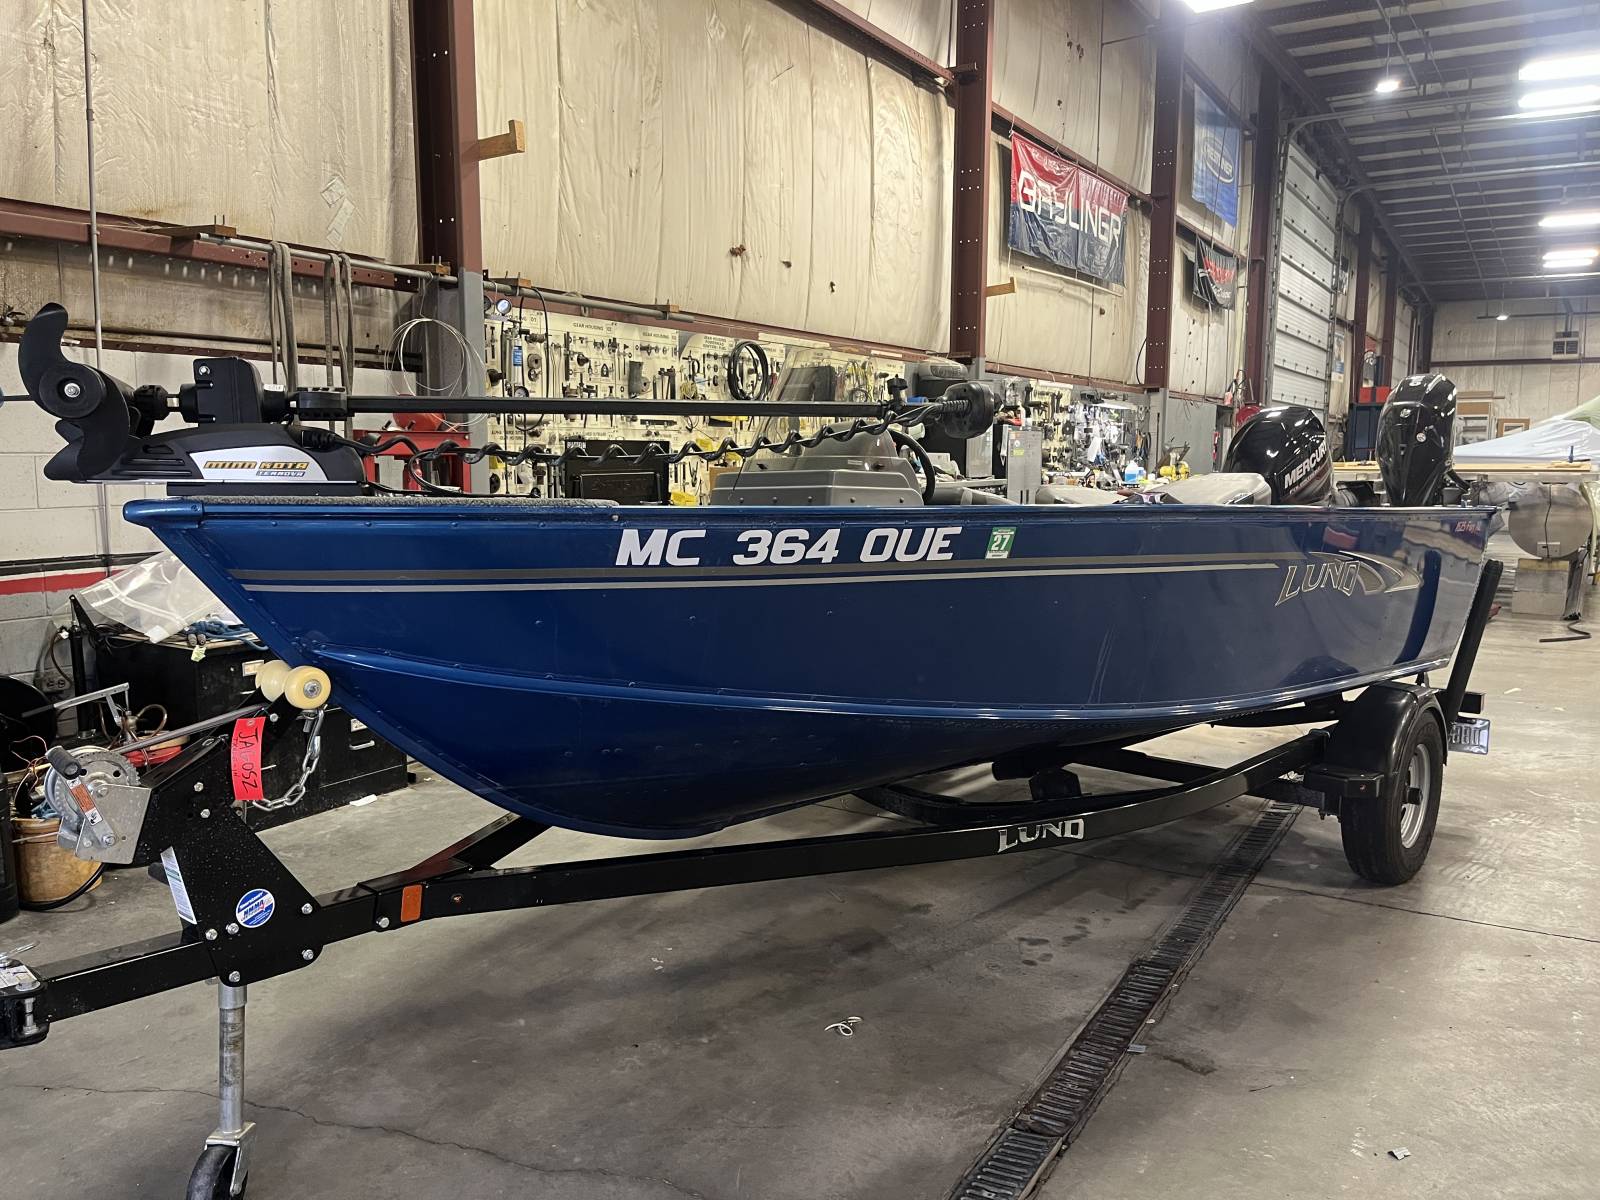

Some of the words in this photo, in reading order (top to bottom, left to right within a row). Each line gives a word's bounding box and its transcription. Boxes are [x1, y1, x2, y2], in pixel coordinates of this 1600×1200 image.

[259, 462, 309, 470] KOTA
[615, 528, 706, 566] MC
[732, 528, 841, 565] 364
[859, 527, 963, 563] OUE
[991, 534, 1011, 551] 27
[1275, 560, 1360, 606] LUND
[997, 819, 1084, 853] LUND
